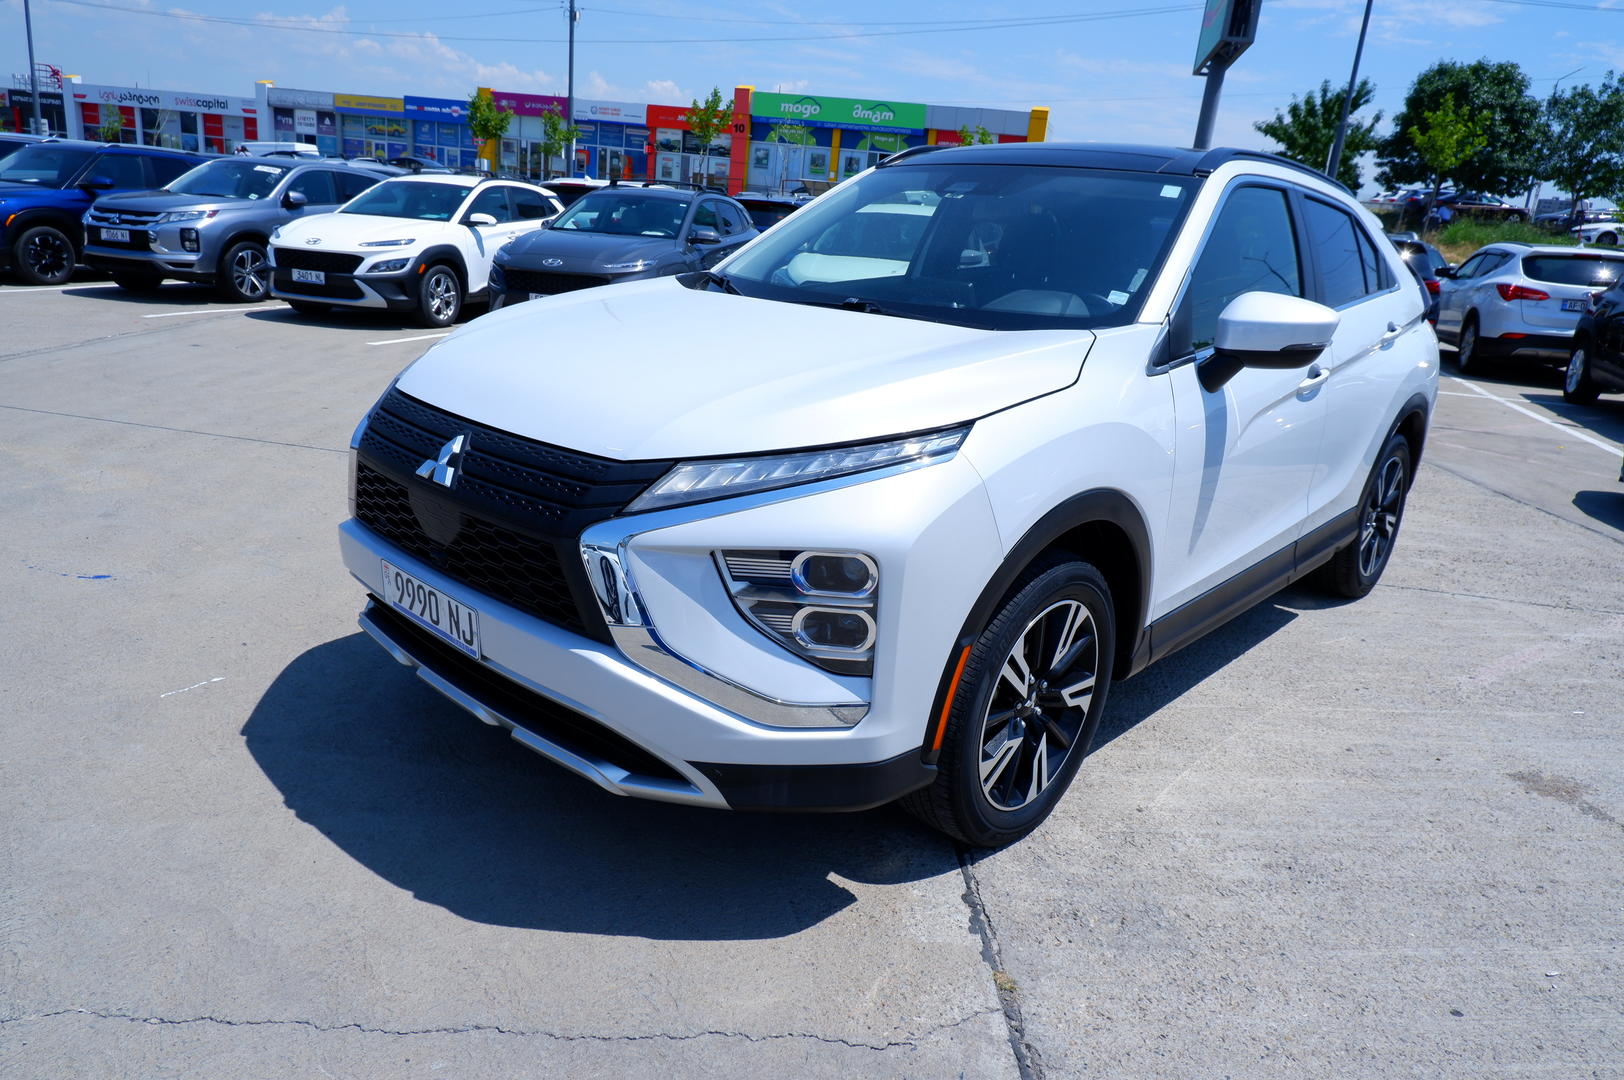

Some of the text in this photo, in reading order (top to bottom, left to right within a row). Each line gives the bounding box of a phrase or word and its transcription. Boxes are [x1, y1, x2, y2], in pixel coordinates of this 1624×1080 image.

[175, 97, 229, 110] swisscapital
[780, 102, 820, 118] mogo
[733, 123, 745, 133] 10
[394, 571, 440, 627] 9990
[447, 599, 474, 647] NJ
